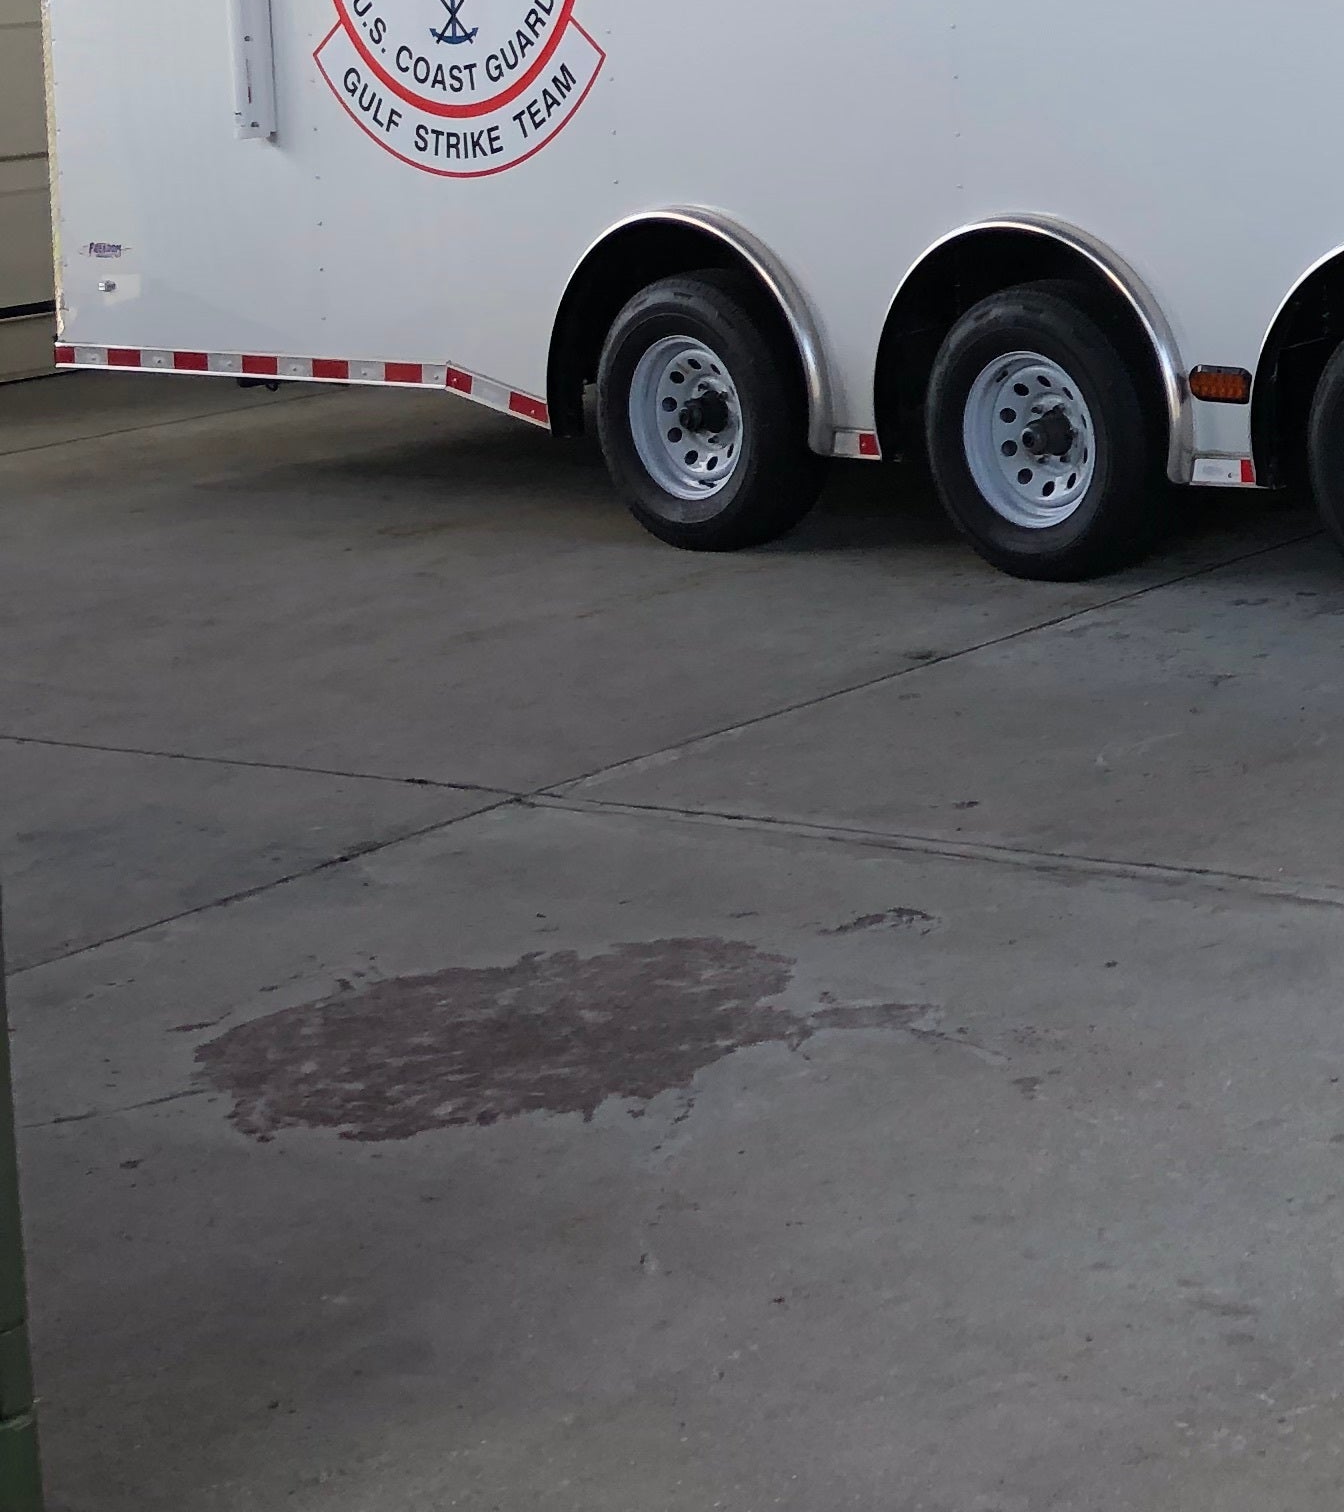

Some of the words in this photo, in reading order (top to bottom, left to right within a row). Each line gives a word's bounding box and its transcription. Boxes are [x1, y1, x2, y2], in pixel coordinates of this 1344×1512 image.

[395, 45, 477, 92] COAST
[343, 66, 402, 134] GULF
[414, 124, 505, 159] STRIKE
[512, 63, 578, 138] TEAM
